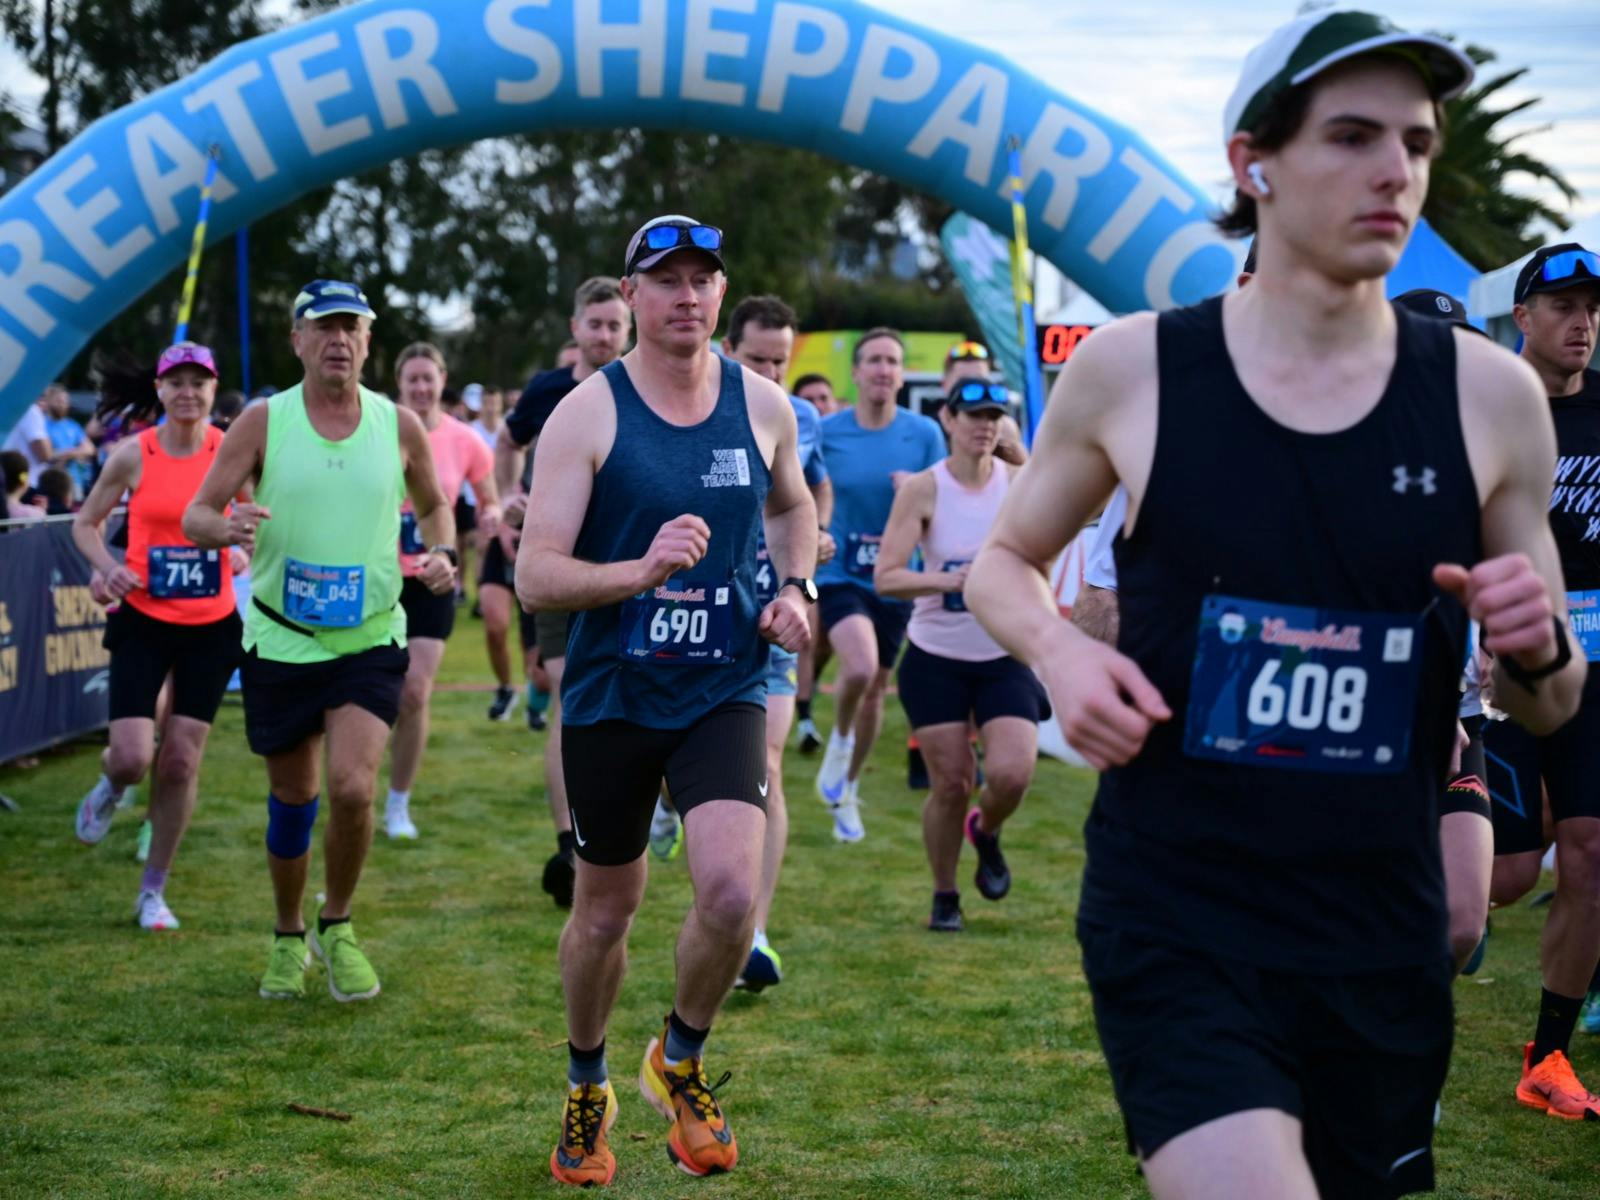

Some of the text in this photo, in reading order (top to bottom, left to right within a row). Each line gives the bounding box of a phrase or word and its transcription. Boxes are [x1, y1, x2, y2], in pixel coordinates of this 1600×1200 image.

[712, 449, 736, 461] WE
[710, 462, 737, 474] ARE
[701, 473, 739, 487] TEAM
[166, 562, 204, 587] 714
[650, 607, 709, 643] 690
[1568, 613, 1600, 633] ATHA
[1247, 659, 1367, 733] 608
